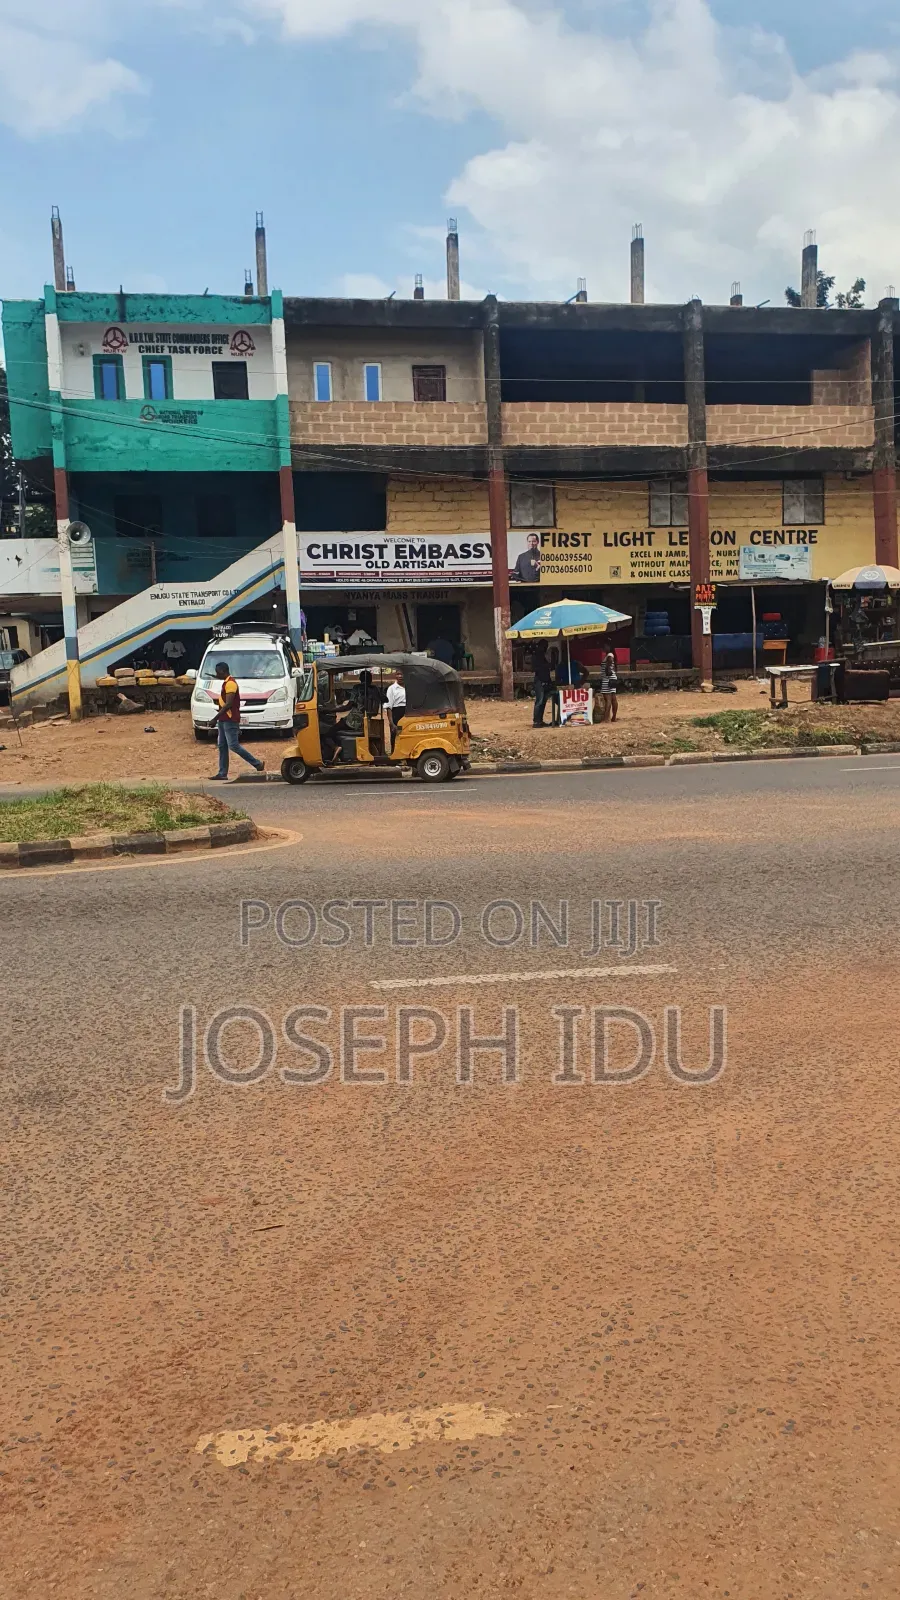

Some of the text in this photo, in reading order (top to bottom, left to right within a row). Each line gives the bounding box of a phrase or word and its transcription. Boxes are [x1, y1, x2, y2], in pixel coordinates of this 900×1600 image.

[212, 334, 229, 345] OFFICE
[138, 345, 223, 354] CHIEF TASK FORCE
[540, 530, 818, 548] FIRST LIGHT LEON CENTRE
[306, 544, 388, 560] CHRIST
[541, 554, 592, 562] 08060395540
[365, 560, 444, 569] OLD ARTISAN
[541, 565, 592, 574] 07036056010
